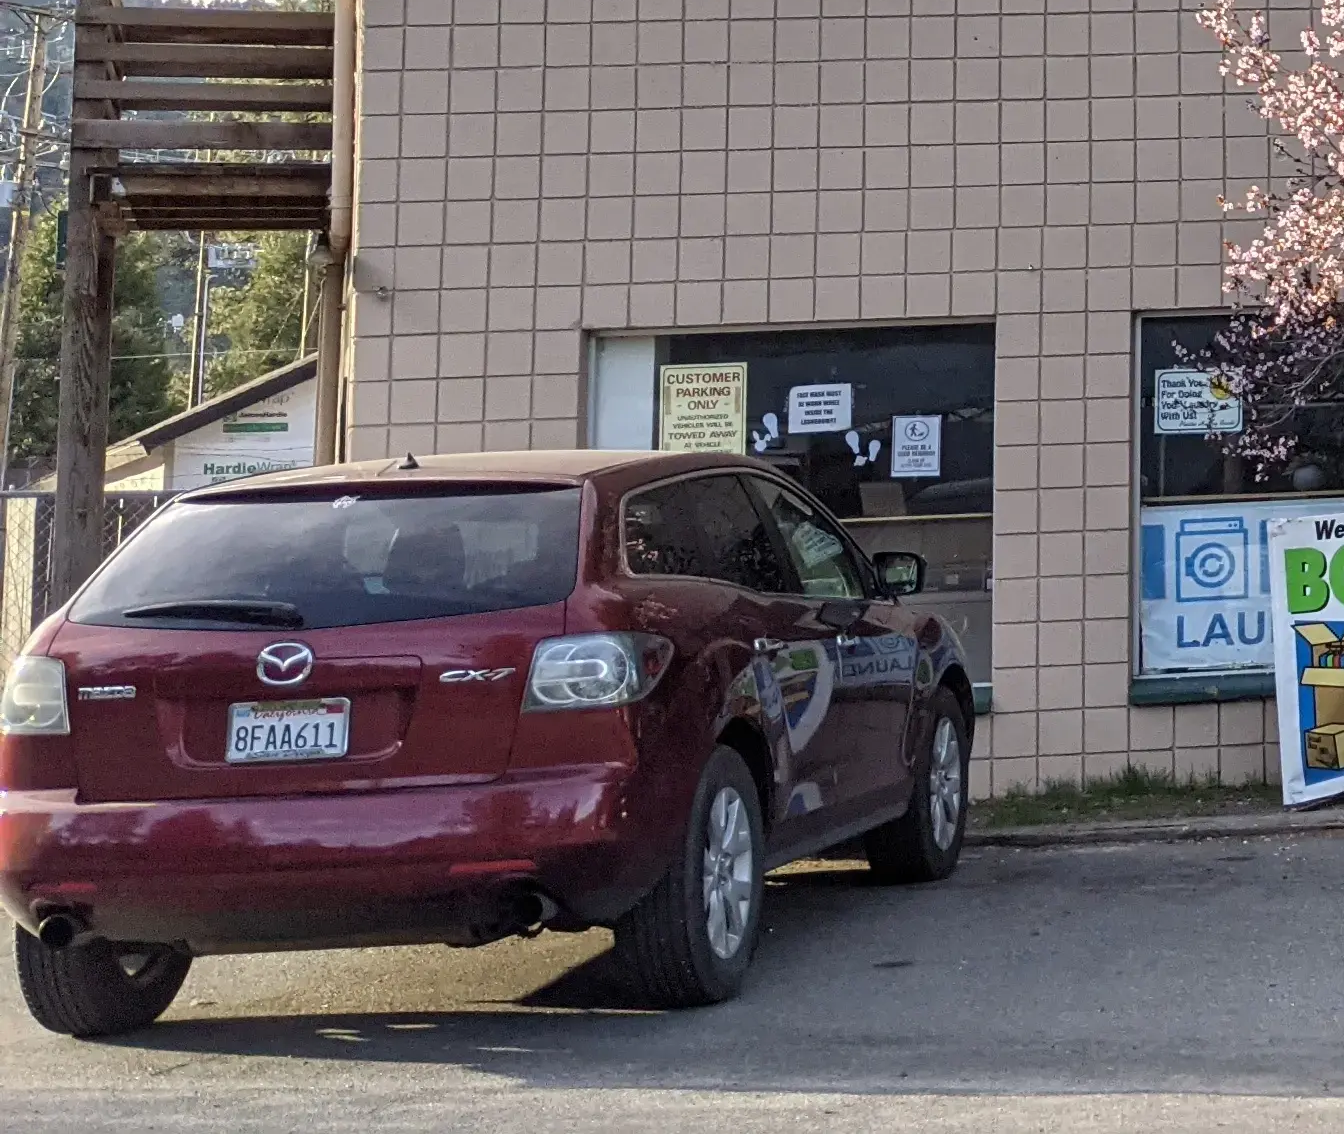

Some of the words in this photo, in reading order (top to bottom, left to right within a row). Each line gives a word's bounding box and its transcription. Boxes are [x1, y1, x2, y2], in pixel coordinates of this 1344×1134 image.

[667, 372, 741, 384] CUSTOMER
[1161, 379, 1187, 388] Thank
[676, 386, 731, 398] PARKING
[1161, 390, 1176, 398] For
[687, 399, 719, 410] ONLY
[668, 431, 706, 440] TOWED
[709, 430, 738, 439] AWAY
[1176, 611, 1273, 648] LAU
[439, 668, 516, 683] CX-7
[234, 721, 338, 753] 8FAA611
